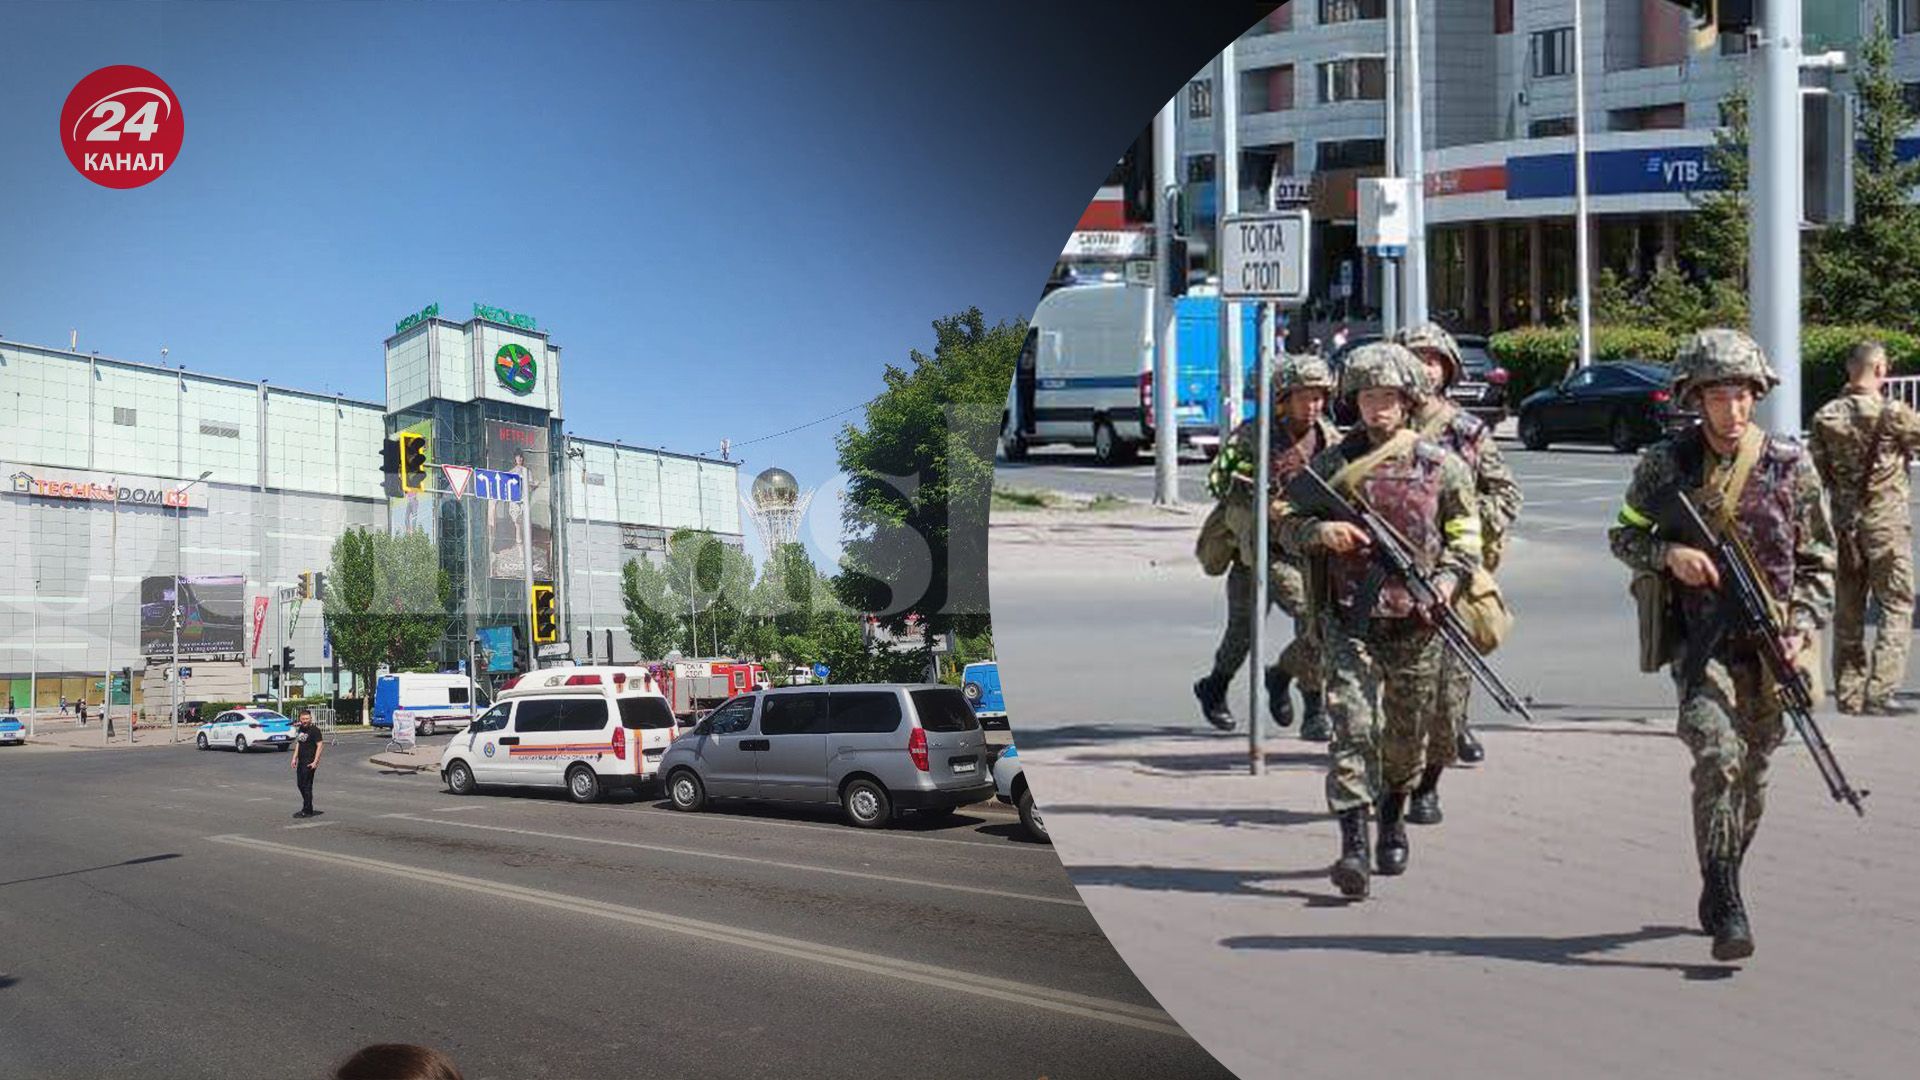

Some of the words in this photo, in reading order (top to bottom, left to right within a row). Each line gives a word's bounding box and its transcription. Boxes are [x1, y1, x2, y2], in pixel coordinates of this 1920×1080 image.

[1663, 160, 1699, 184] VTB
[1239, 223, 1285, 257] ТОҚТА
[1242, 260, 1281, 290] СТОП
